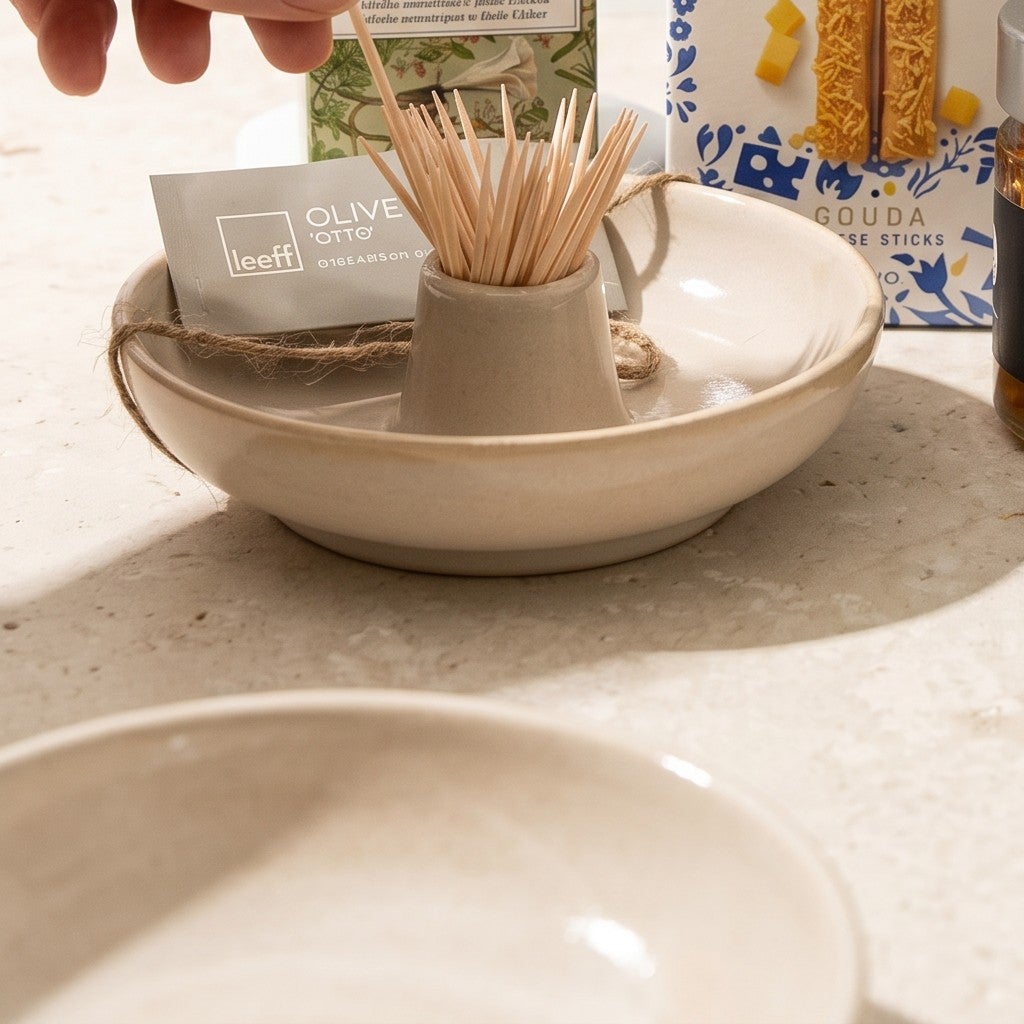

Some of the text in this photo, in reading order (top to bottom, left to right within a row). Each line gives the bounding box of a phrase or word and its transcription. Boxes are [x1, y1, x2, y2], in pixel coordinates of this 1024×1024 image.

[305, 196, 403, 227] OLIVE
[815, 206, 925, 226] GOUDA
[880, 233, 944, 246] STICKS
[232, 243, 294, 271] leeff
